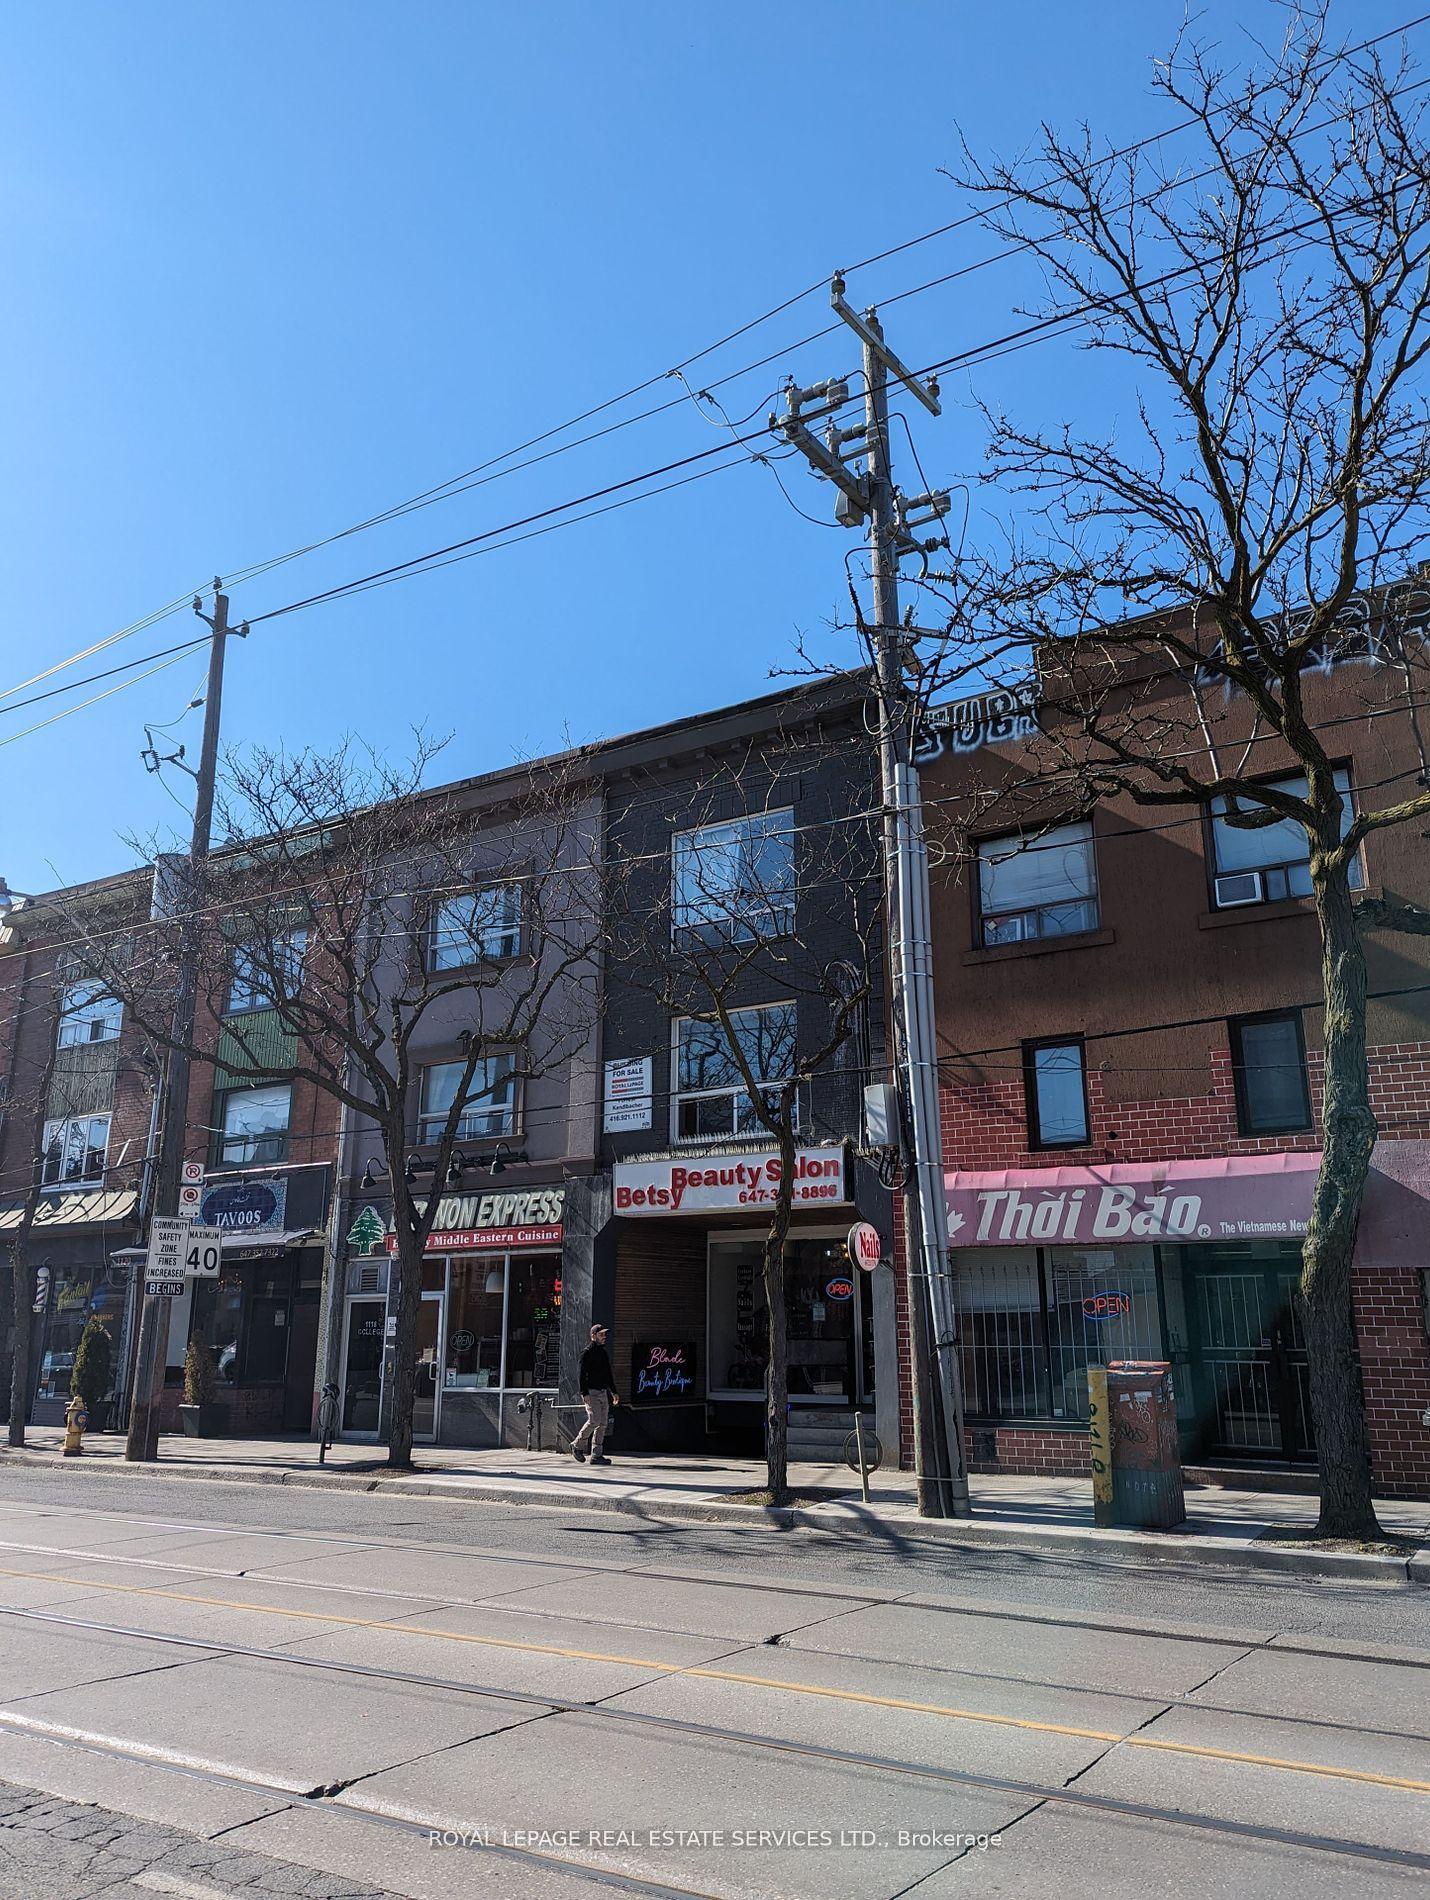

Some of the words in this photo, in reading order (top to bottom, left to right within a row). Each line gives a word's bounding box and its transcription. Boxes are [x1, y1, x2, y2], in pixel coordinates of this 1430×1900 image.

[627, 1067, 643, 1075] SALE
[671, 1162, 762, 1189] Beauty
[616, 1184, 685, 1210] Betsy
[476, 1190, 565, 1227] EXPRESS
[1092, 1185, 1202, 1237] Báo
[215, 1210, 261, 1226] TAVOOS
[153, 1220, 188, 1231] COMMUNITY
[1220, 1221, 1236, 1233] The
[1237, 1220, 1287, 1233] Vietnamese
[158, 1232, 182, 1242] SAFETY
[189, 1231, 219, 1240] MAXIMUM
[434, 1233, 470, 1246] Middle
[473, 1232, 514, 1244] Eastern
[517, 1230, 559, 1241] Cuisine
[160, 1244, 177, 1253] ZONE
[860, 1232, 880, 1259] Nails
[158, 1257, 177, 1266] FINES
[187, 1246, 218, 1271] 40
[147, 1268, 184, 1278] INCREASED
[149, 1282, 181, 1294] BEGINS
[829, 1283, 852, 1295] OPEN
[1082, 1297, 1129, 1314] OPEN
[357, 1328, 384, 1336] COLLEGE
